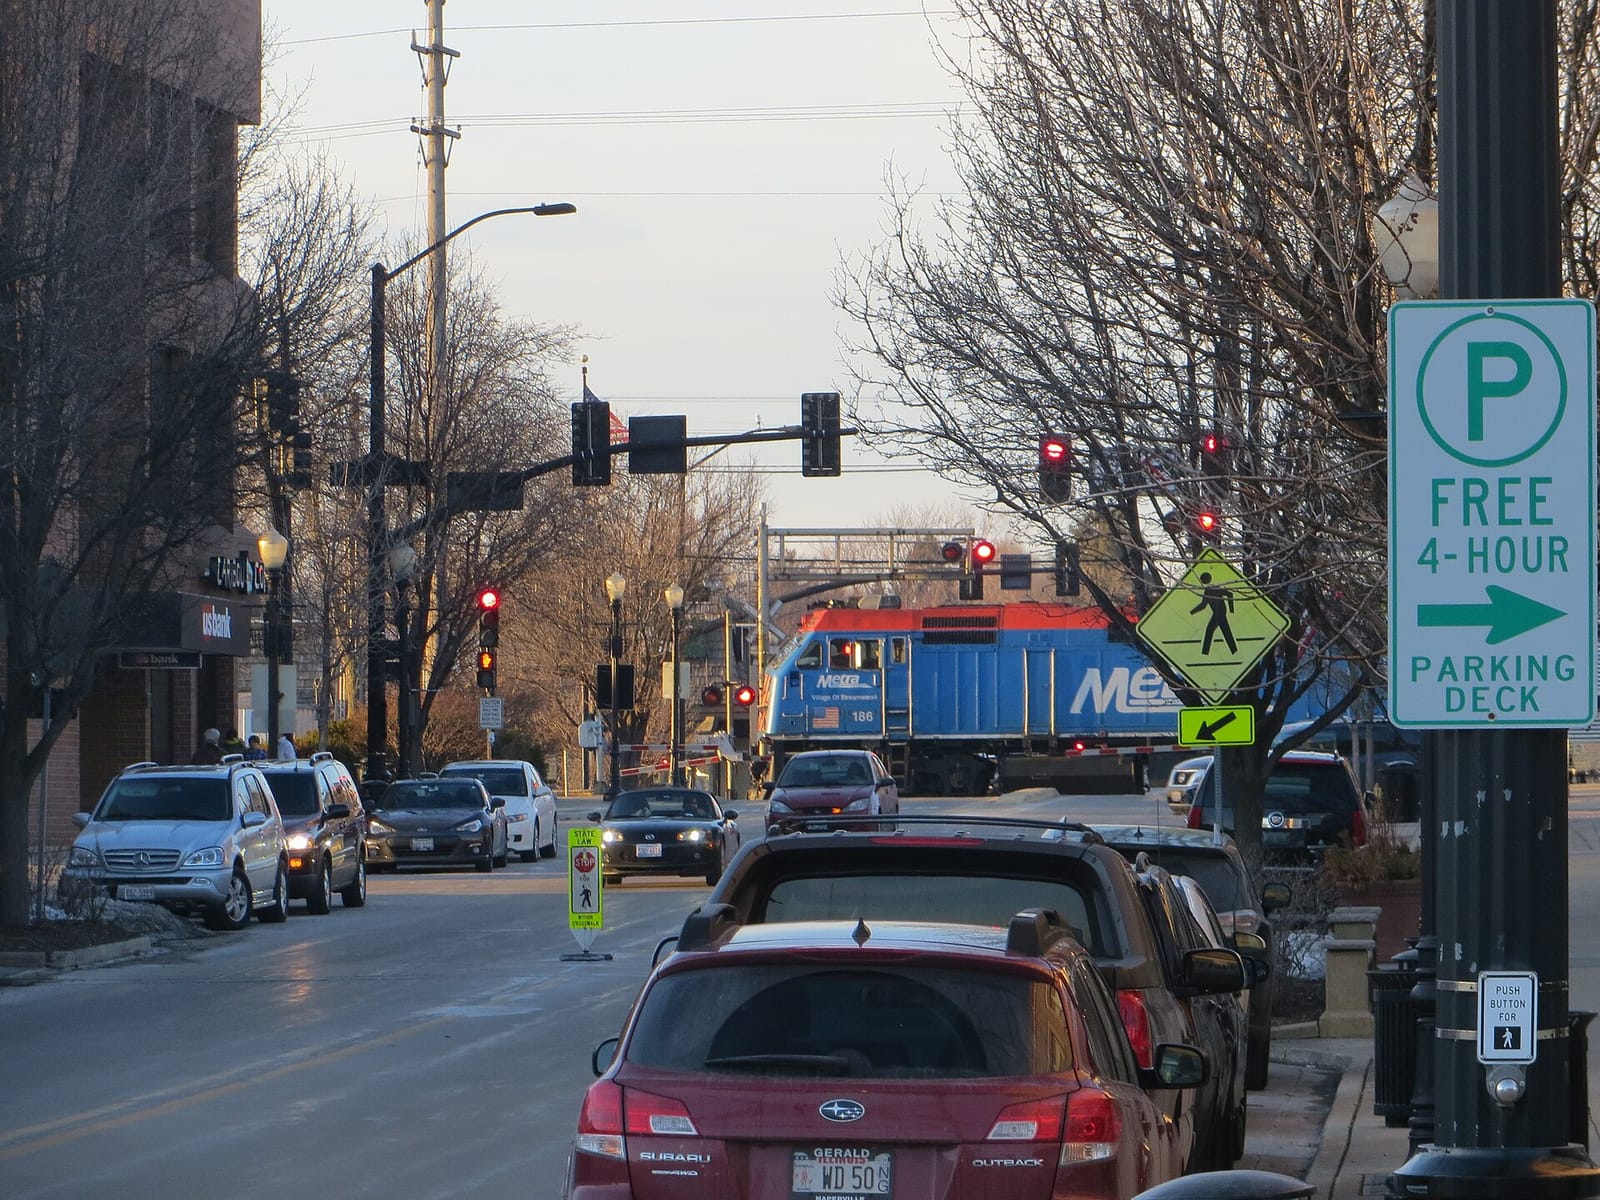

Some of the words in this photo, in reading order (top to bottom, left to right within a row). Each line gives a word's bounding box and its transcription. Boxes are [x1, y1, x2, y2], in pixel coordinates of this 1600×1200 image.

[1467, 342, 1533, 441] P
[1432, 477, 1553, 526] FREE
[1417, 535, 1569, 574] 4-HOUR
[150, 654, 179, 664] bank
[1411, 655, 1575, 682] PARKING
[816, 674, 860, 688] Metra
[1445, 686, 1541, 712] DECK
[852, 711, 873, 721] 186
[574, 830, 596, 838] STATE
[575, 858, 595, 867] STOP
[1496, 986, 1520, 995] PUSH
[1490, 999, 1526, 1009] BUTTON
[1499, 1012, 1517, 1021] FOR
[640, 1152, 711, 1162] SUBARU
[813, 1147, 870, 1158] GERALD
[972, 1159, 1044, 1167] OUTBACK
[822, 1166, 845, 1190] WD
[852, 1166, 875, 1190] 50
